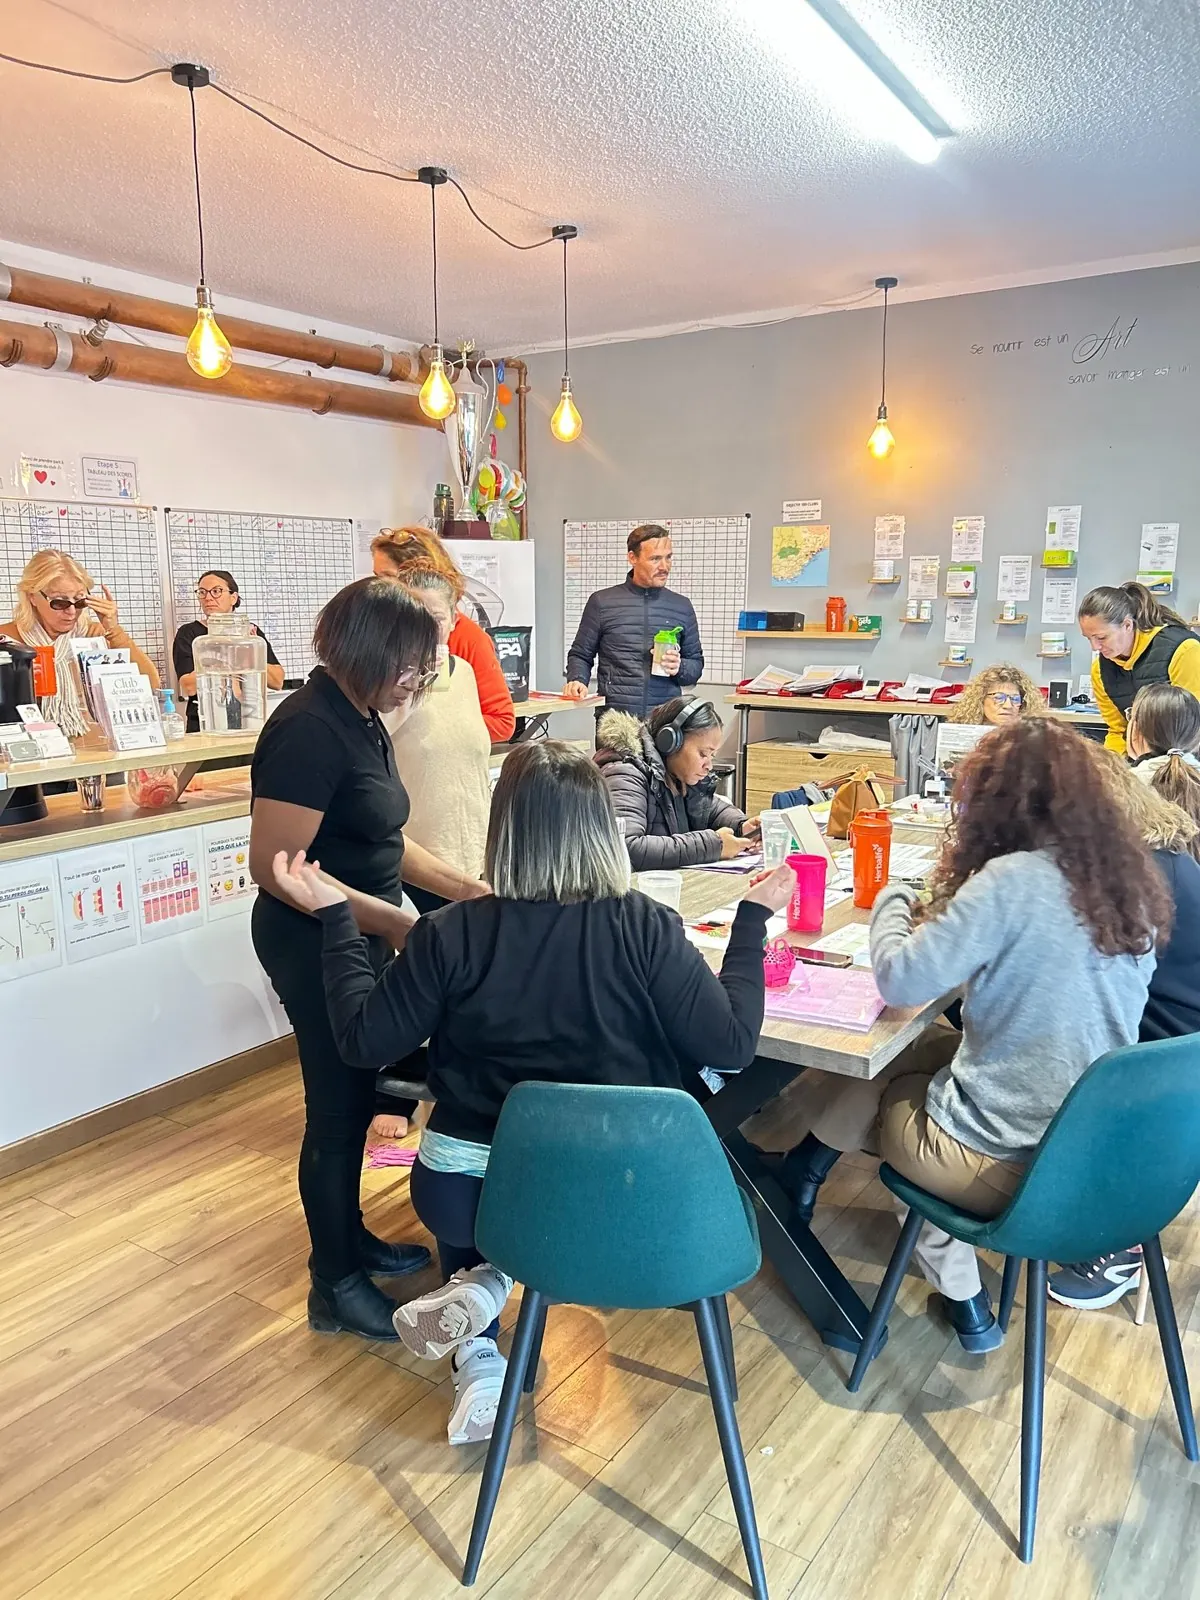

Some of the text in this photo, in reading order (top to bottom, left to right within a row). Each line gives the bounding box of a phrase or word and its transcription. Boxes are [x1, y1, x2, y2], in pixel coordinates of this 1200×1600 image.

[970, 344, 984, 354] Se
[1034, 336, 1051, 346] est
[1057, 333, 1069, 344] un
[1072, 316, 1138, 364] Art
[498, 643, 522, 660] 24
[114, 678, 138, 689] Club
[874, 847, 883, 882] Herbalife
[477, 1352, 496, 1360] VANS
